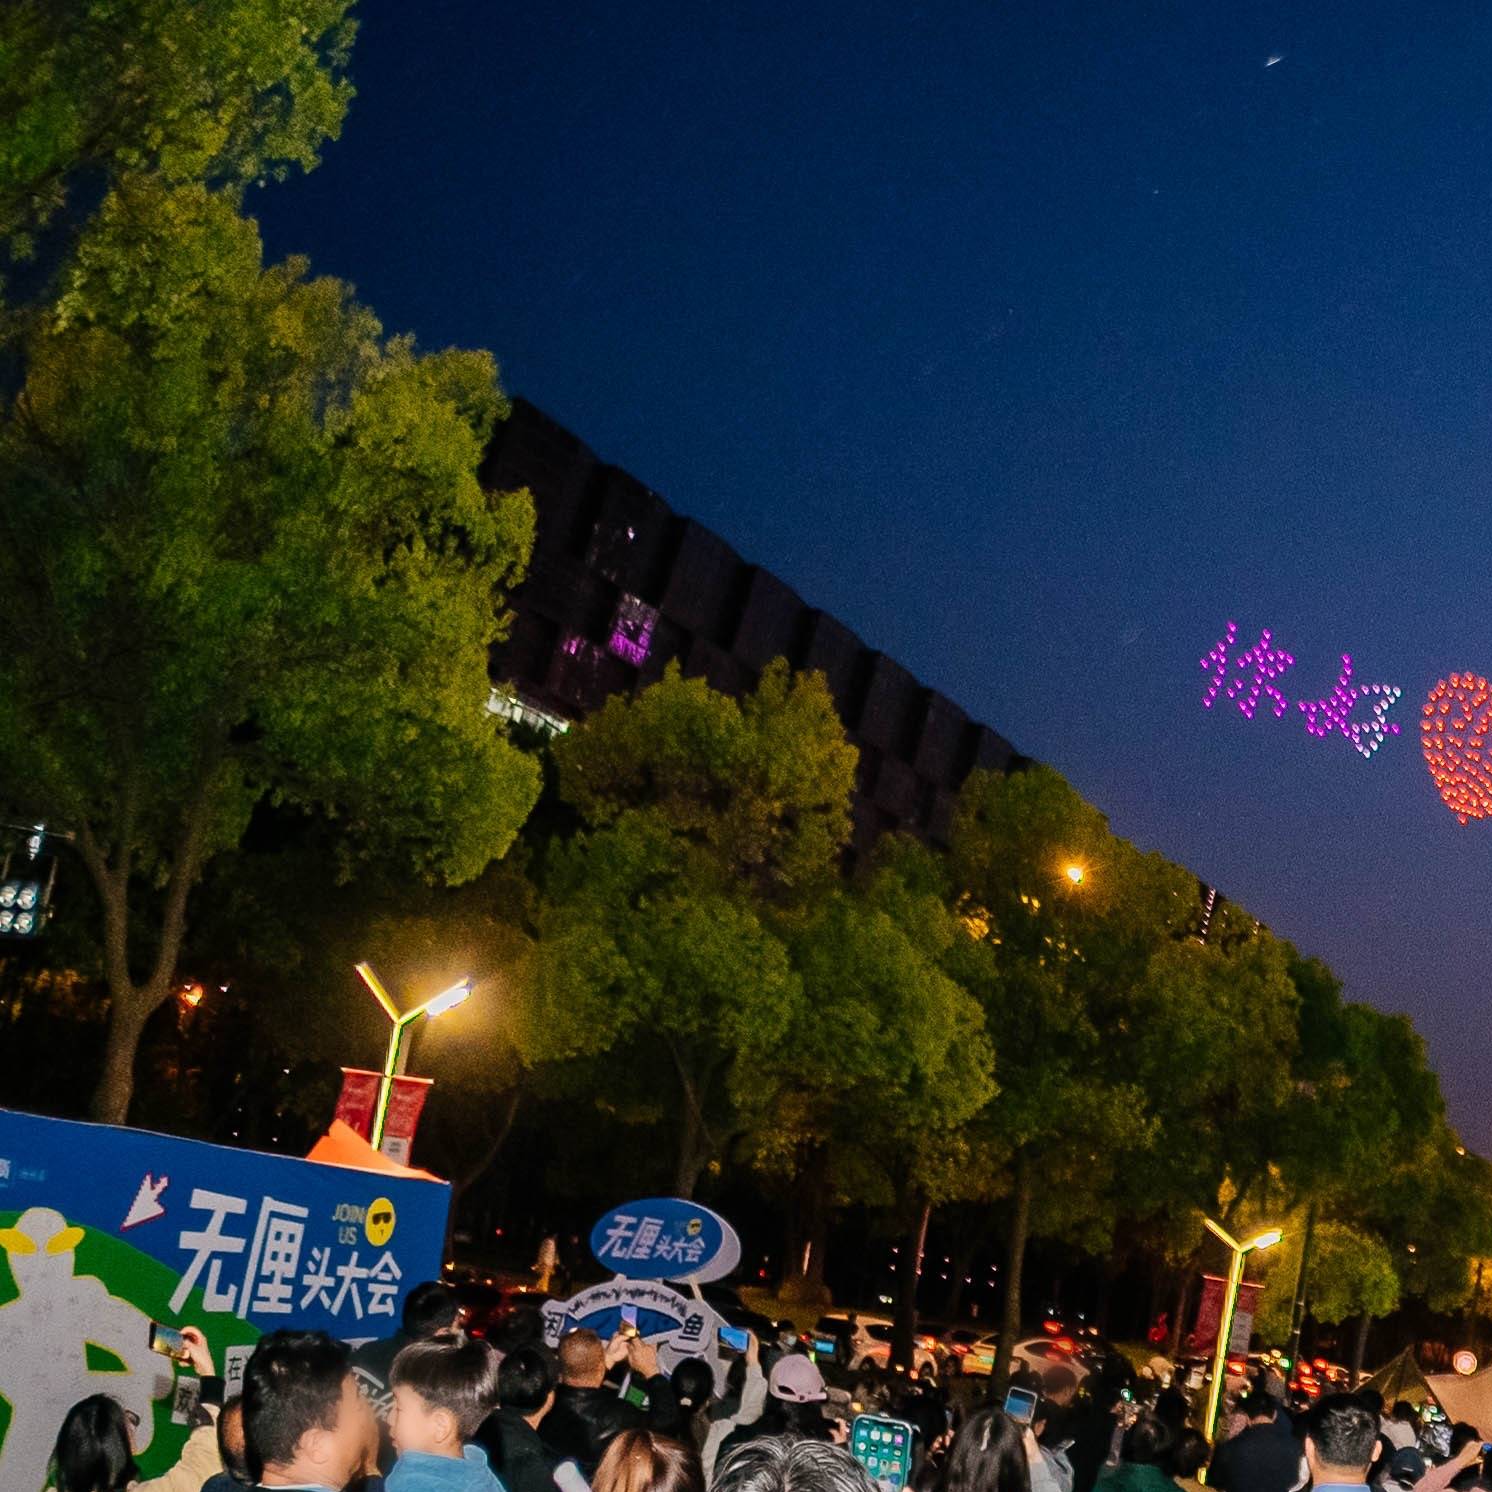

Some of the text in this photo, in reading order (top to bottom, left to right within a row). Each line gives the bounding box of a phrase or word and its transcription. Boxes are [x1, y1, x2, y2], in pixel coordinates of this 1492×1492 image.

[332, 1203, 367, 1224] JOIN
[338, 1226, 358, 1246] US
[598, 1214, 706, 1264] 无厘头大会
[168, 1187, 404, 1320] 无厘头大会
[677, 1312, 706, 1343] 鱼
